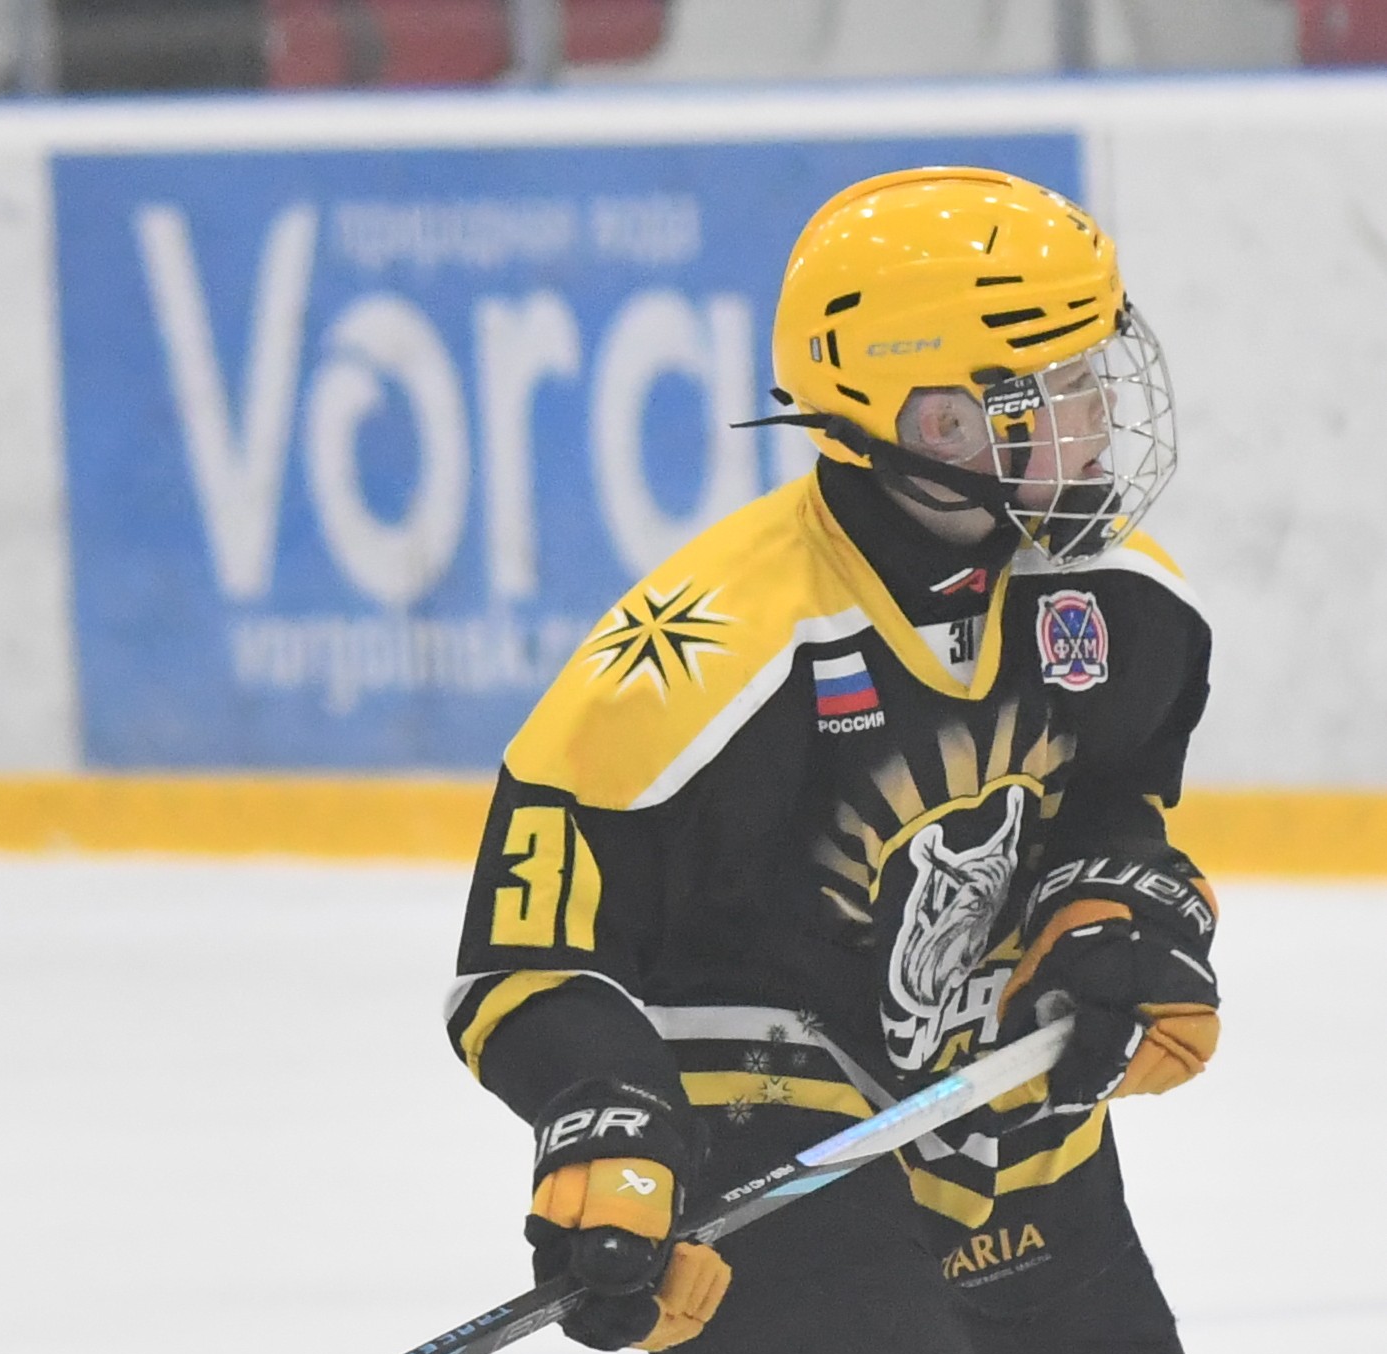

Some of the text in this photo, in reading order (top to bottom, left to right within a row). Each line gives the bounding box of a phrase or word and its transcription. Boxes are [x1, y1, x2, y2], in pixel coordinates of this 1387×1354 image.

[866, 336, 943, 358] CCM
[987, 396, 1041, 417] CCM
[948, 619, 974, 665] 31
[1053, 638, 1098, 659] ФХМ
[817, 711, 886, 734] РОССИЯ
[489, 806, 603, 952] 31
